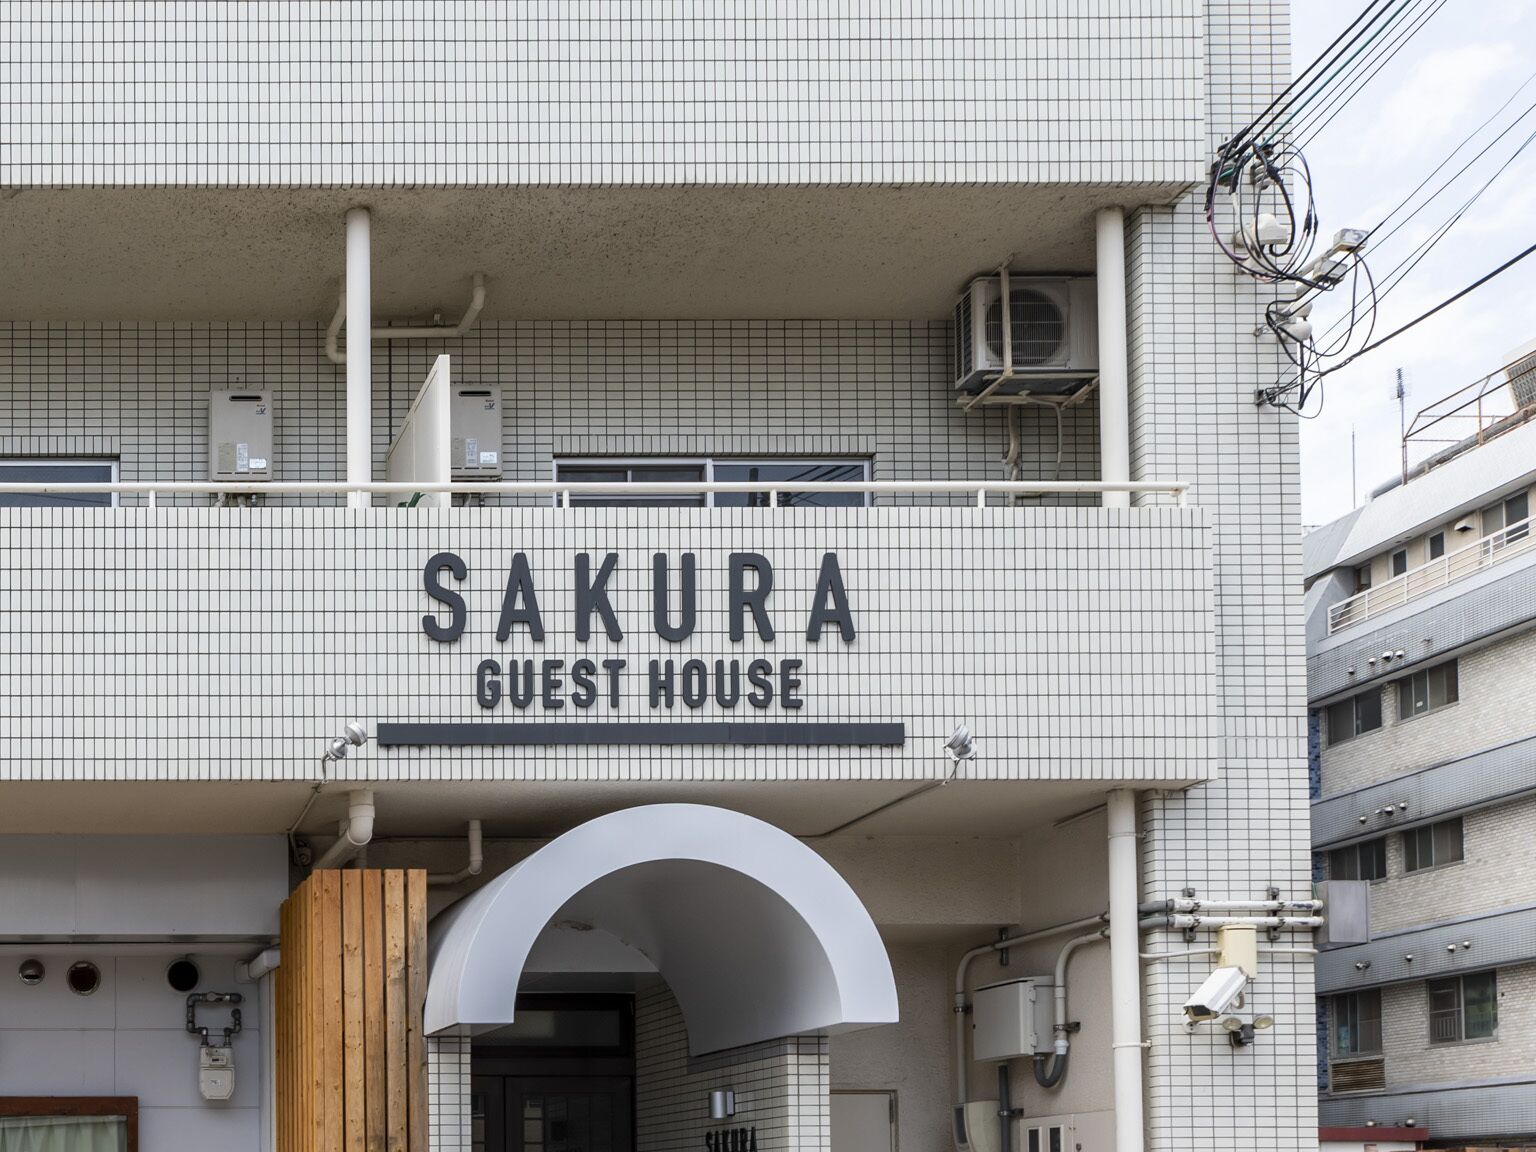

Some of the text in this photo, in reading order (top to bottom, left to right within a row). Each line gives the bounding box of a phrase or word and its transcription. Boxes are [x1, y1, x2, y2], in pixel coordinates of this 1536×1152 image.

[422, 552, 856, 642] SAKURA
[476, 658, 804, 709] GUEST HOUSE
